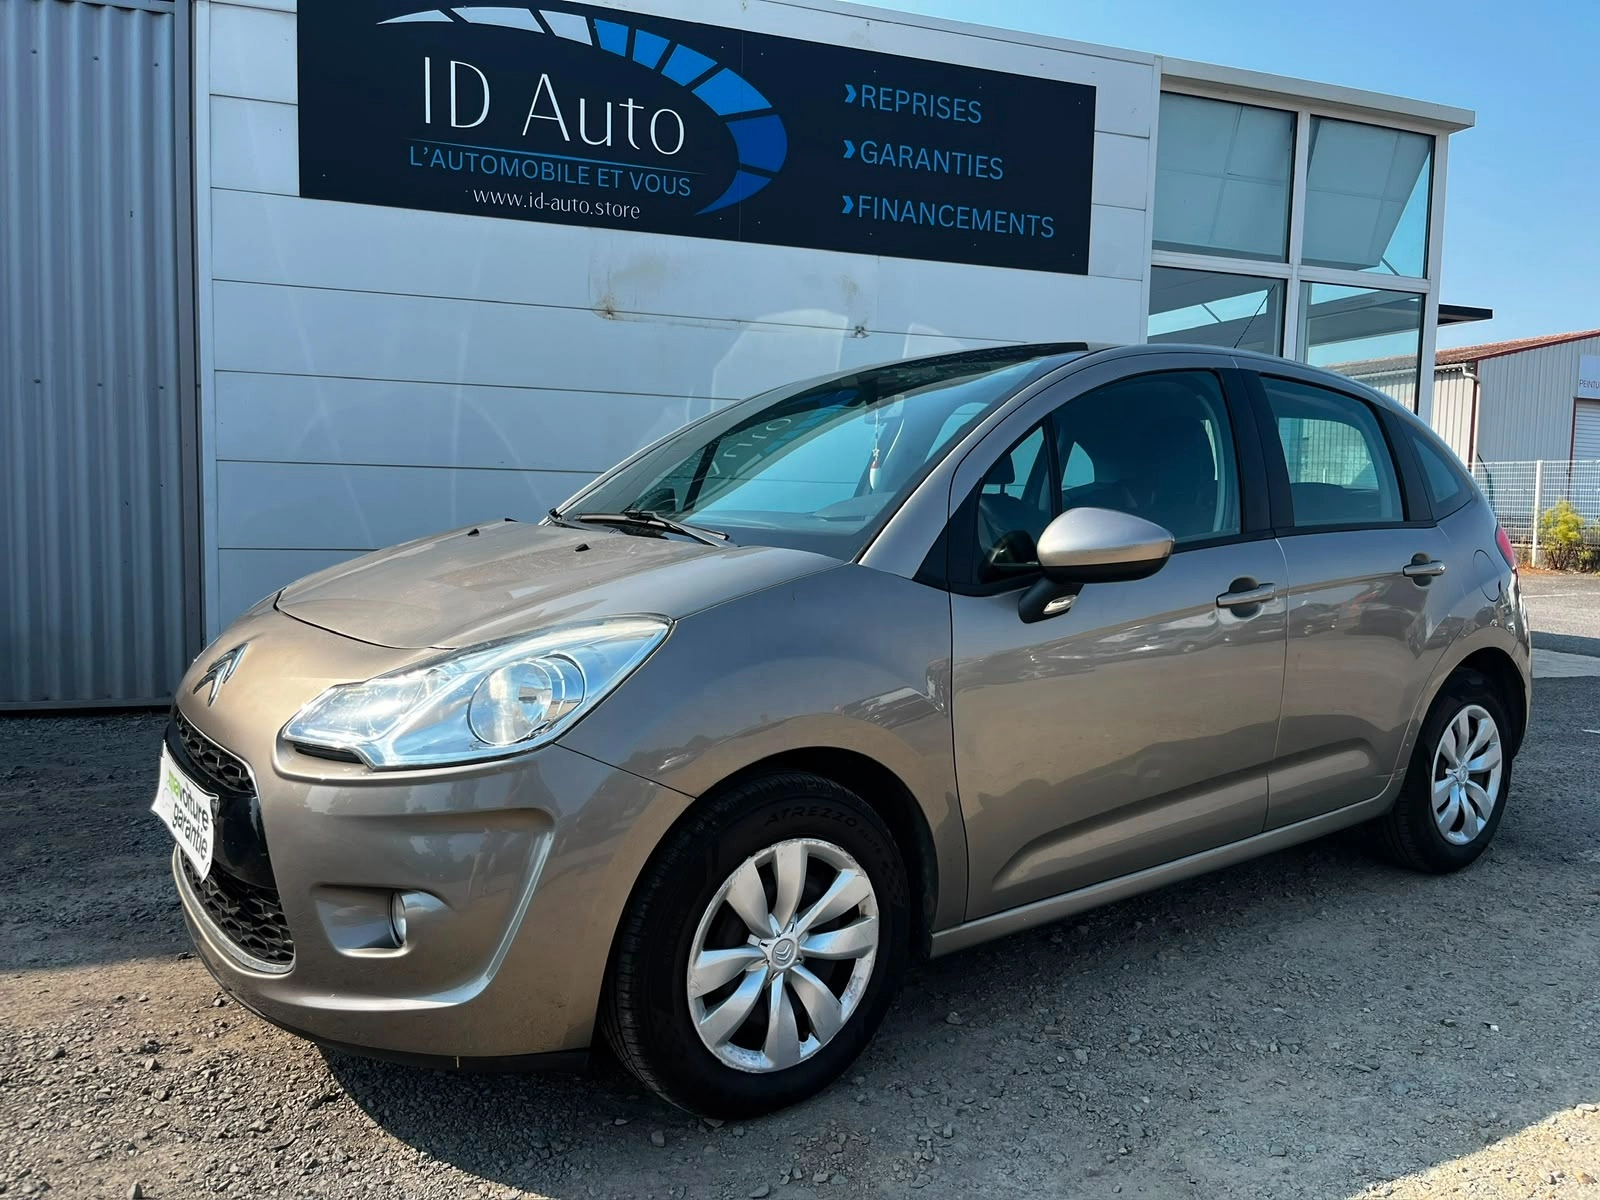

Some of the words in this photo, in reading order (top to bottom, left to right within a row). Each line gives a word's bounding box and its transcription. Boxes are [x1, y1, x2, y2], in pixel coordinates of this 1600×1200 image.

[424, 56, 490, 129] ID
[522, 73, 685, 155] Auto
[861, 84, 982, 124] REPRISES
[410, 146, 590, 185] L’AUTOMOBILE
[598, 168, 623, 188] ET
[629, 171, 691, 196] VOUS
[860, 140, 1004, 180] GARANTIES
[473, 189, 640, 219] www.id-auto.store
[858, 195, 1055, 238] FINANCEMENTS
[172, 803, 208, 861] garantie
[764, 805, 858, 828] ATREZZO
